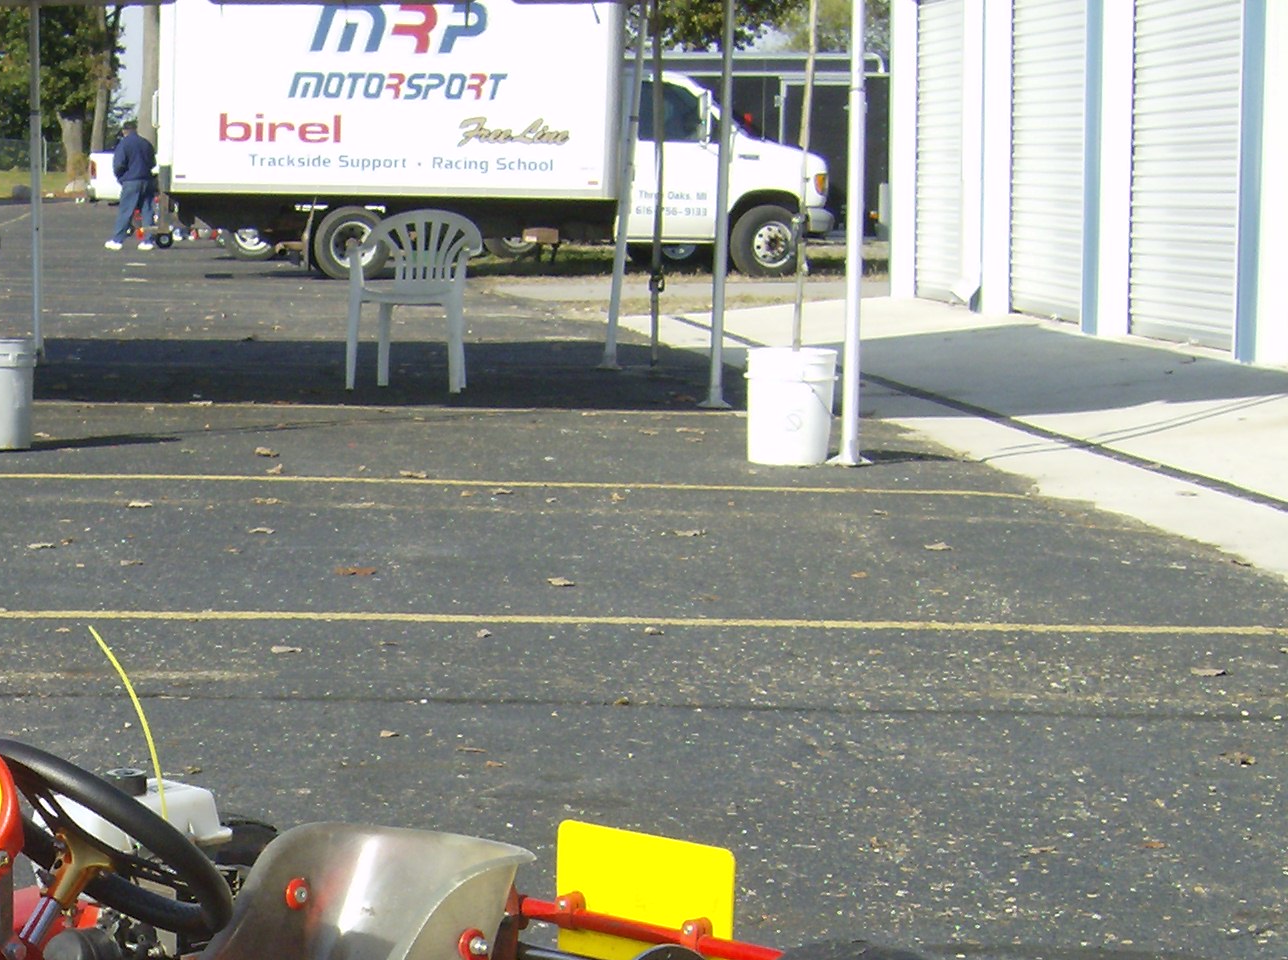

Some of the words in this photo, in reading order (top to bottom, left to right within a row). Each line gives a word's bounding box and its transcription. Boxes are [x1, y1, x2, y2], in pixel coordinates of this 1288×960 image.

[288, 71, 508, 100] MOTORSPORT
[218, 113, 342, 144] birel
[249, 153, 332, 169] Trackside
[338, 155, 407, 171] Support
[432, 157, 489, 174] Racing
[497, 157, 555, 172] School
